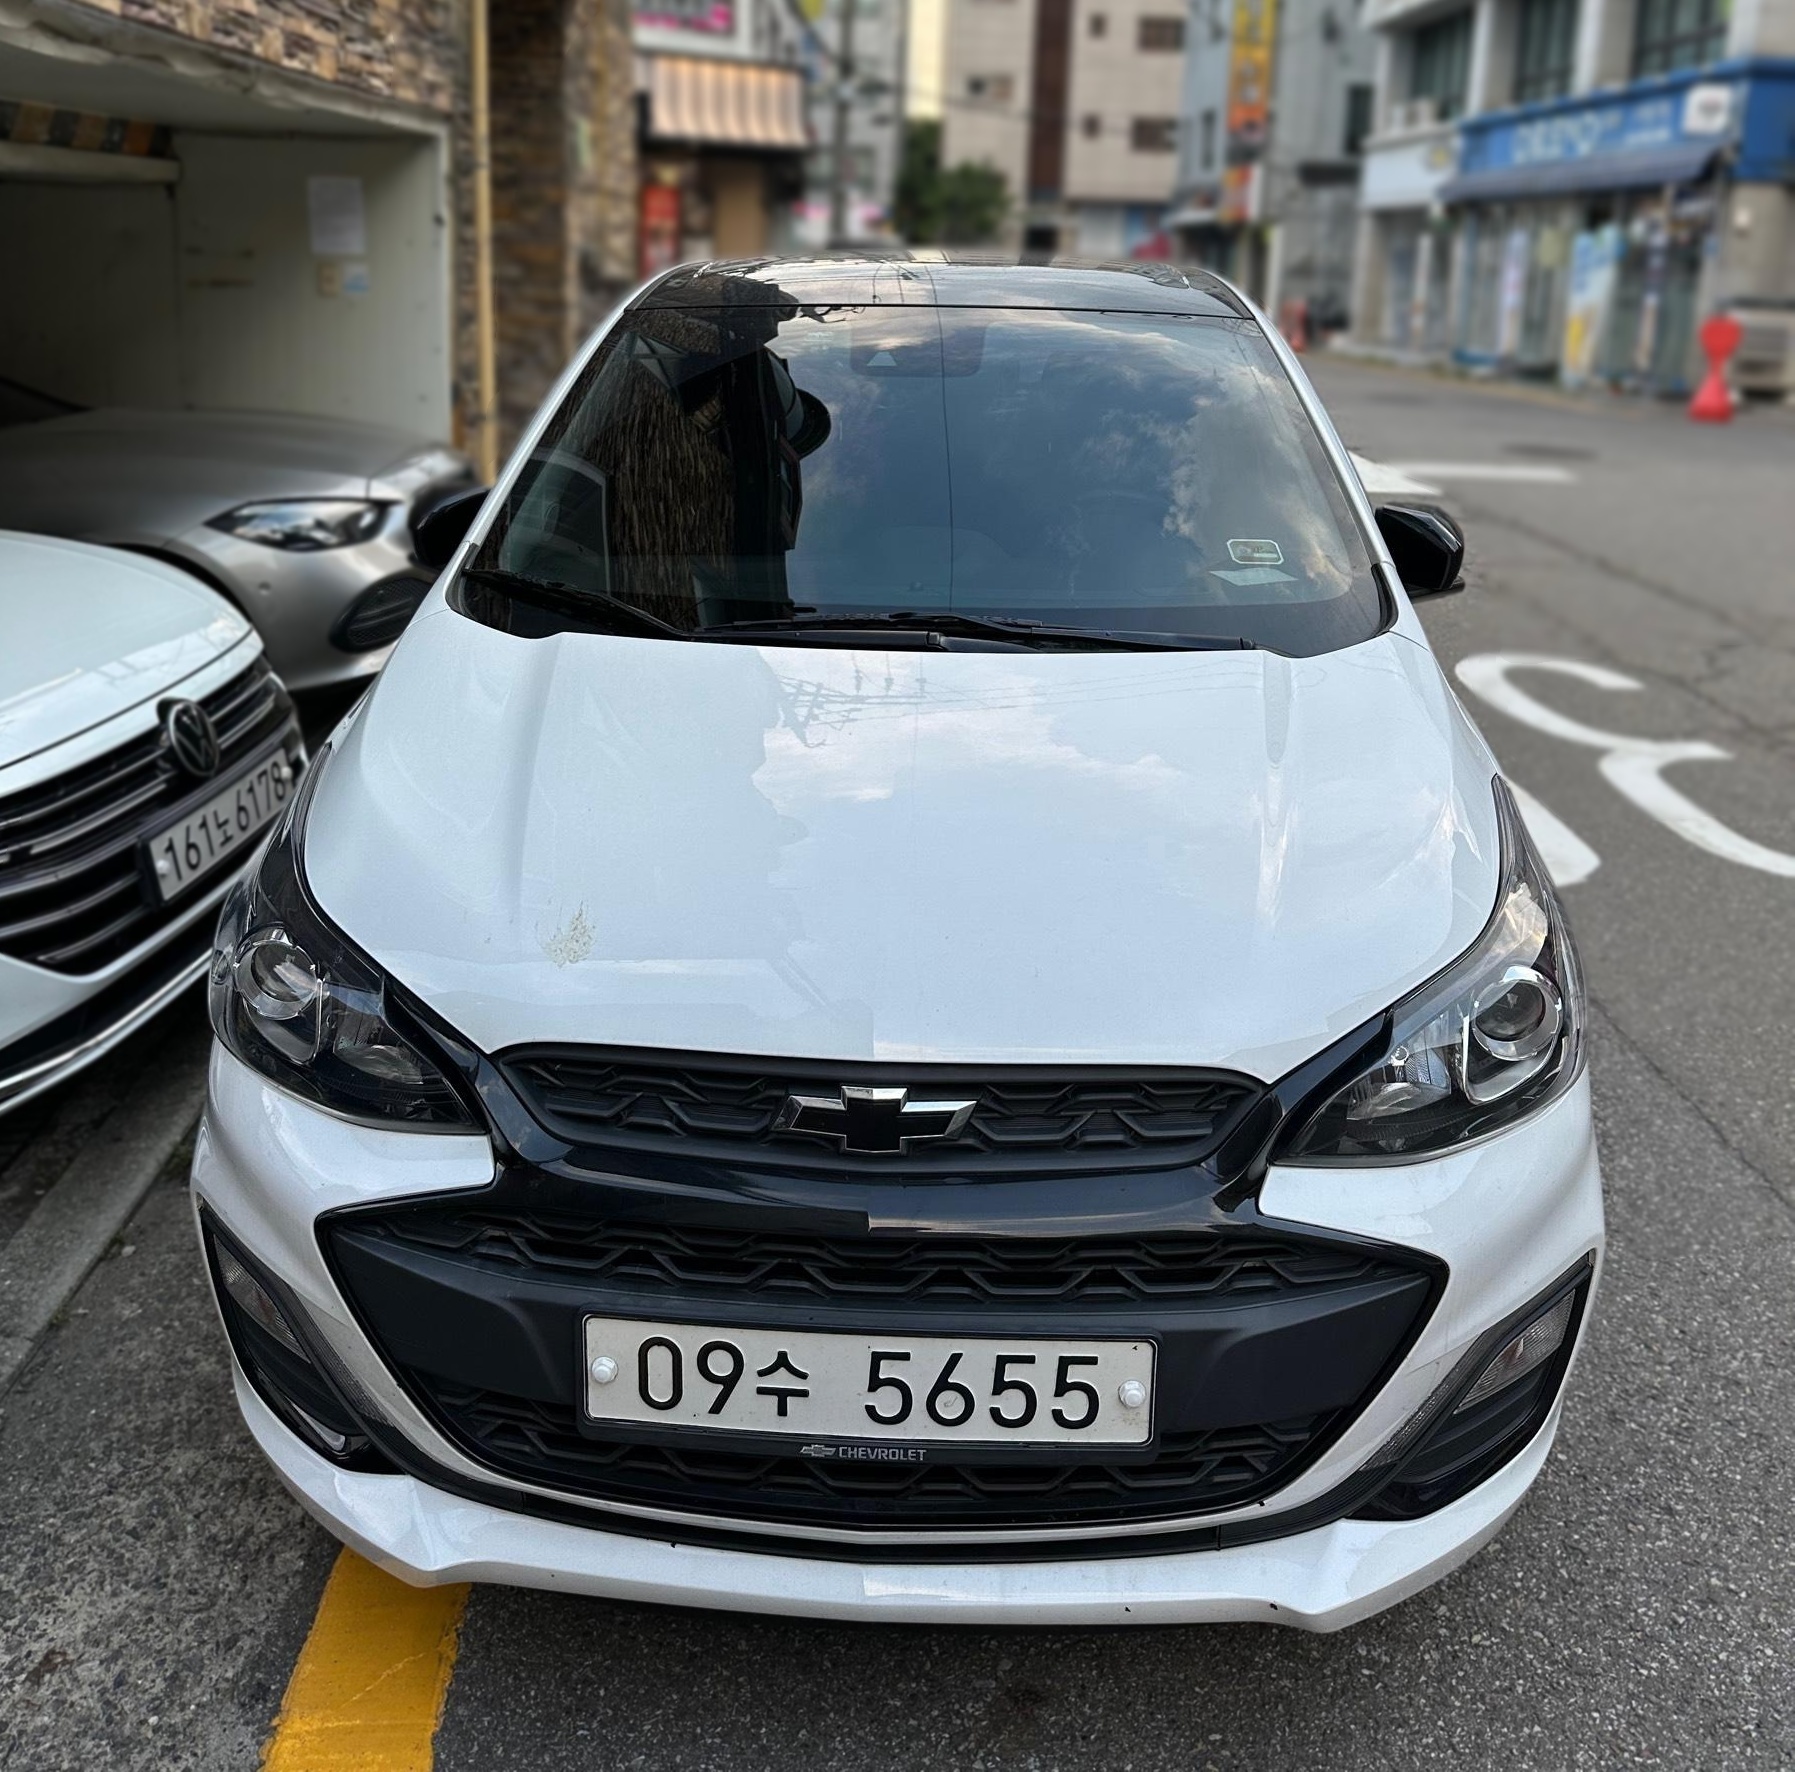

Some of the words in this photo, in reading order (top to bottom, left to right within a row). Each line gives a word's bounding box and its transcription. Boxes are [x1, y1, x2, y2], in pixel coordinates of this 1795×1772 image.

[637, 1336, 810, 1417] 09수
[864, 1351, 1101, 1430] 5655
[838, 1446, 927, 1461] CHEVROLET
